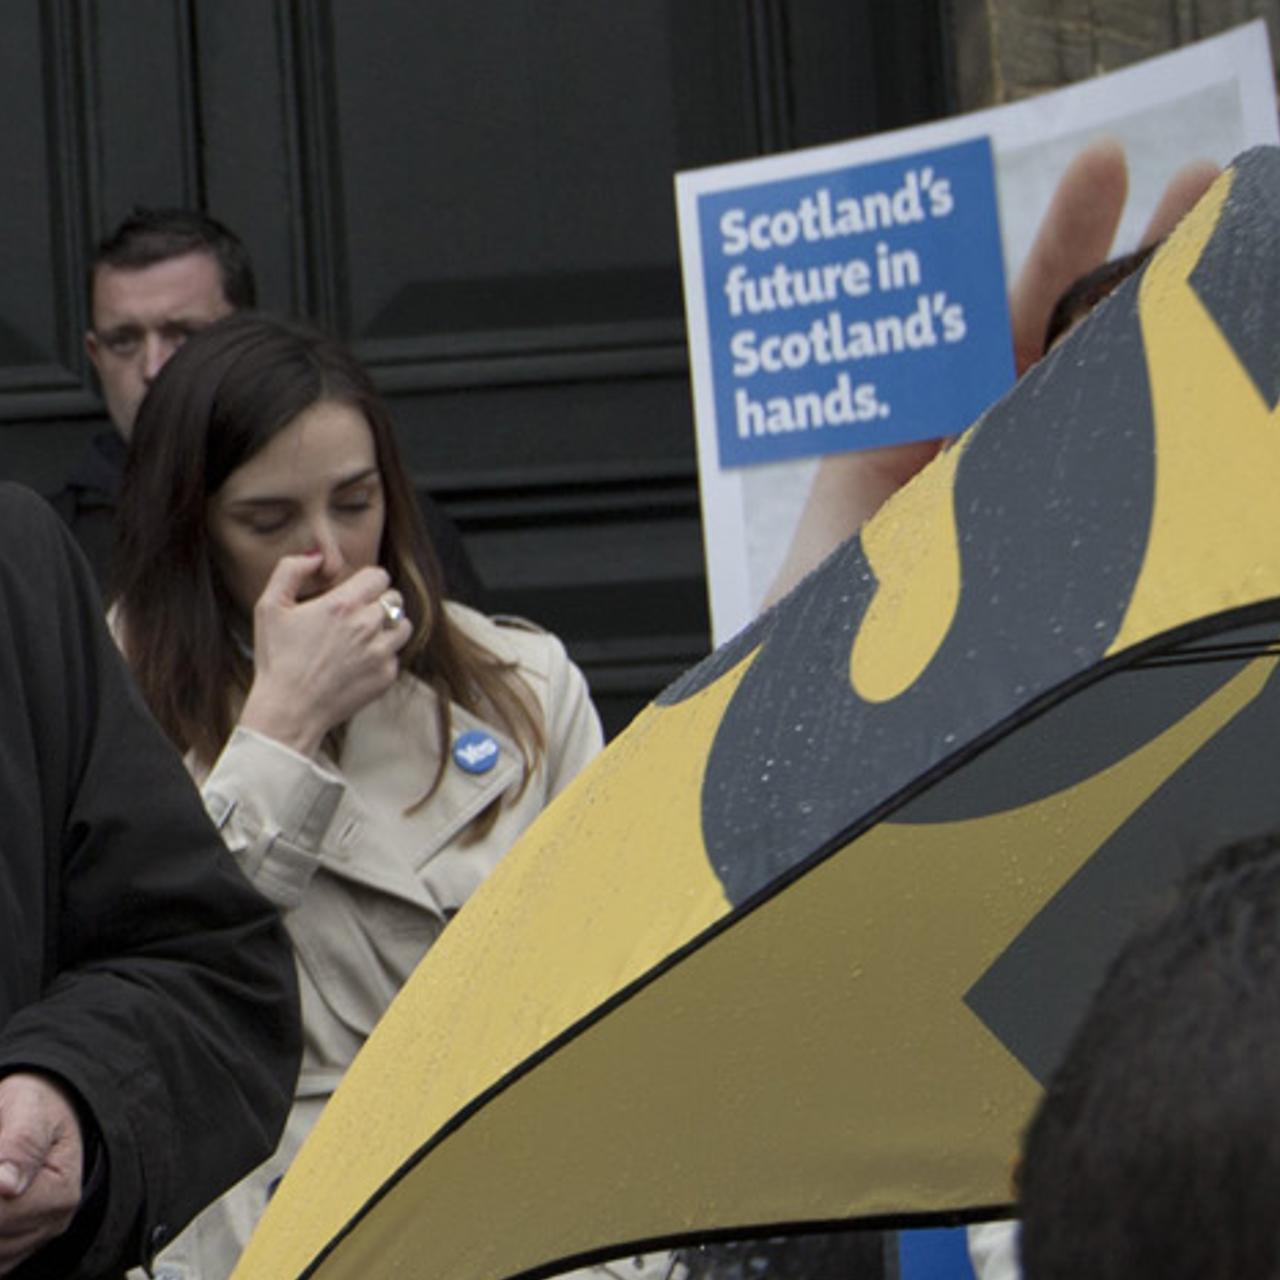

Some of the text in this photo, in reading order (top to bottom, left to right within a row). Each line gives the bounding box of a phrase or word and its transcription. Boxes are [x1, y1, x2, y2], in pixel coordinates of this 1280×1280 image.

[720, 167, 954, 255] Scotland's
[725, 244, 920, 316] future in
[731, 292, 966, 377] Scotland's
[735, 374, 889, 438] hands.
[455, 738, 498, 764] Yes
